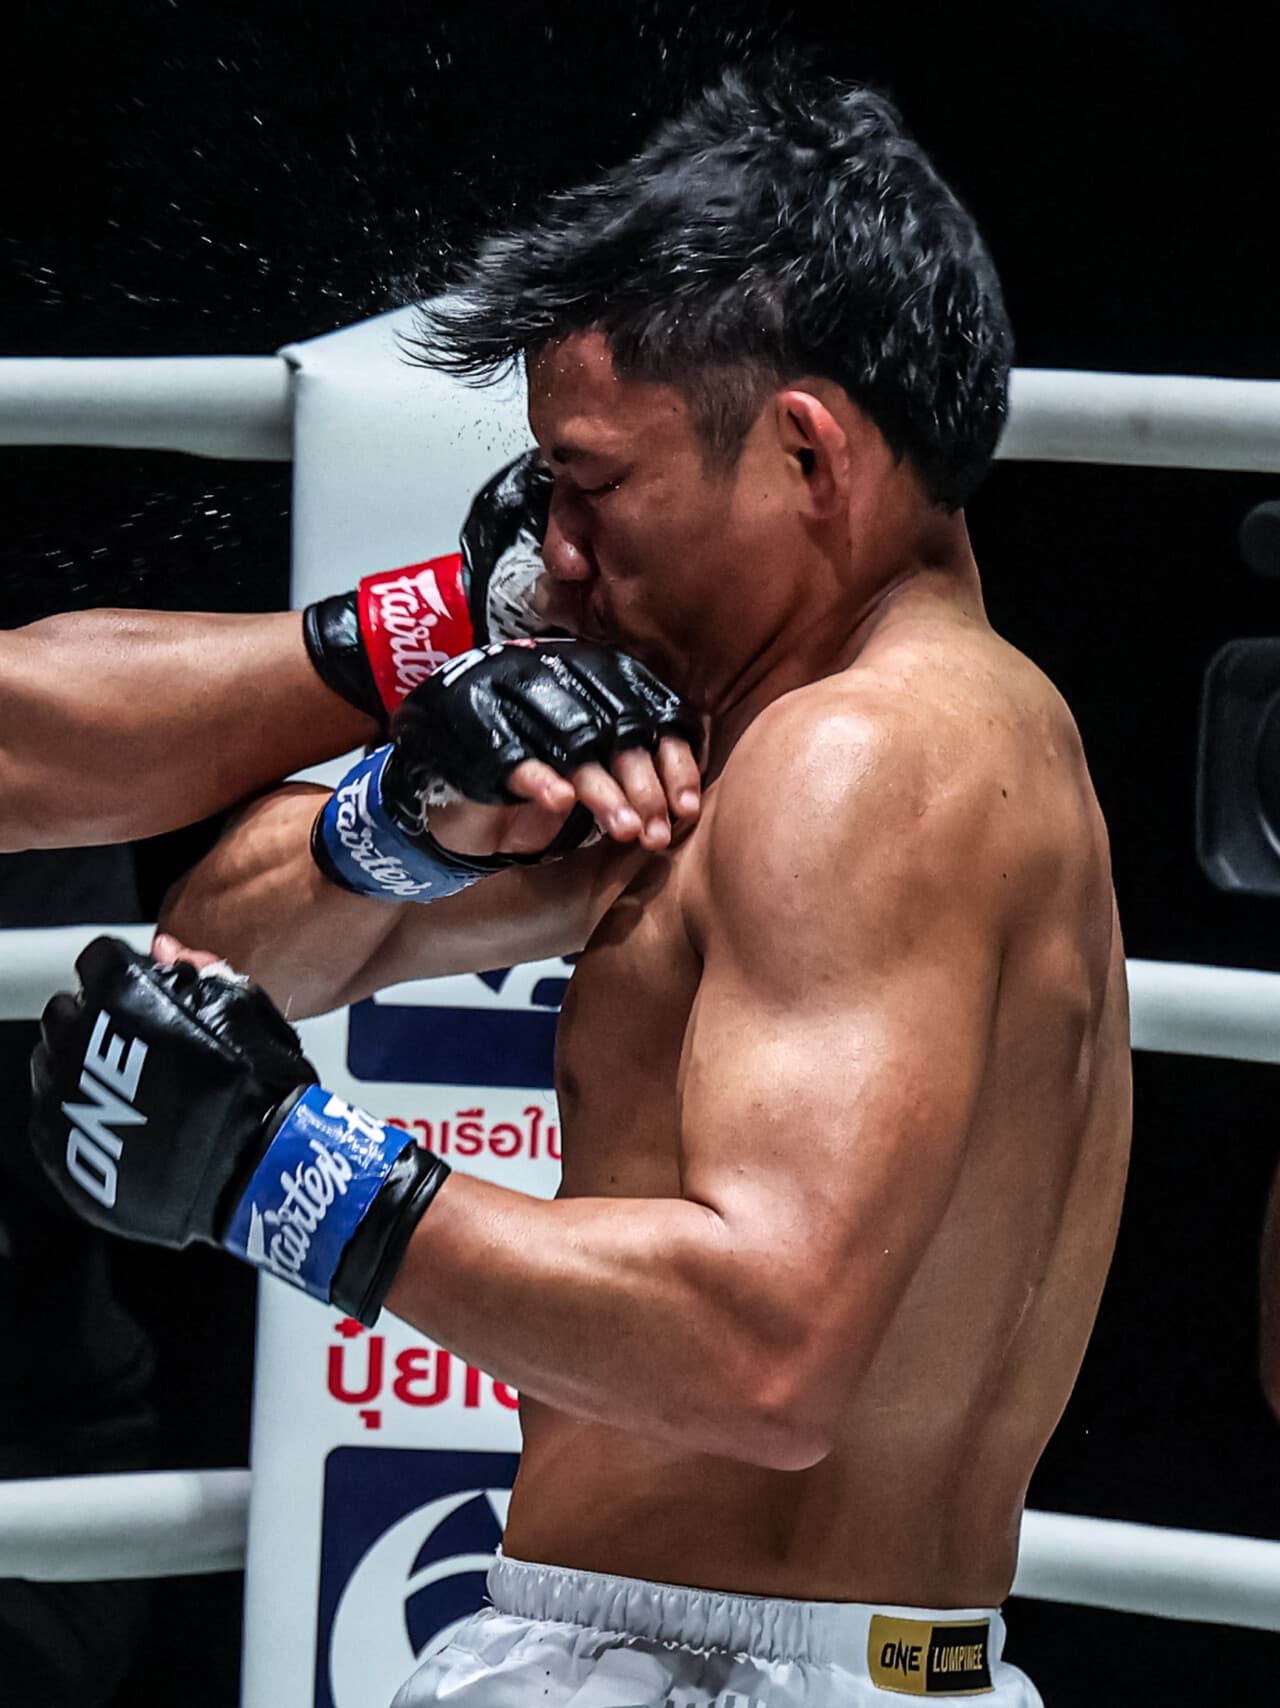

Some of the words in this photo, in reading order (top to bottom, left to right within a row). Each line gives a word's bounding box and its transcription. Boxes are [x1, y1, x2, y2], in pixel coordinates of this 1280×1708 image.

[370, 568, 453, 696] Fairte
[335, 770, 433, 896] Fairtex
[61, 1008, 149, 1209] ONE
[385, 1104, 562, 1161] าเรือใ
[246, 1138, 353, 1287] Fairtex
[880, 1636, 922, 1677] ONE
[932, 1643, 983, 1673] LUMPINEE
